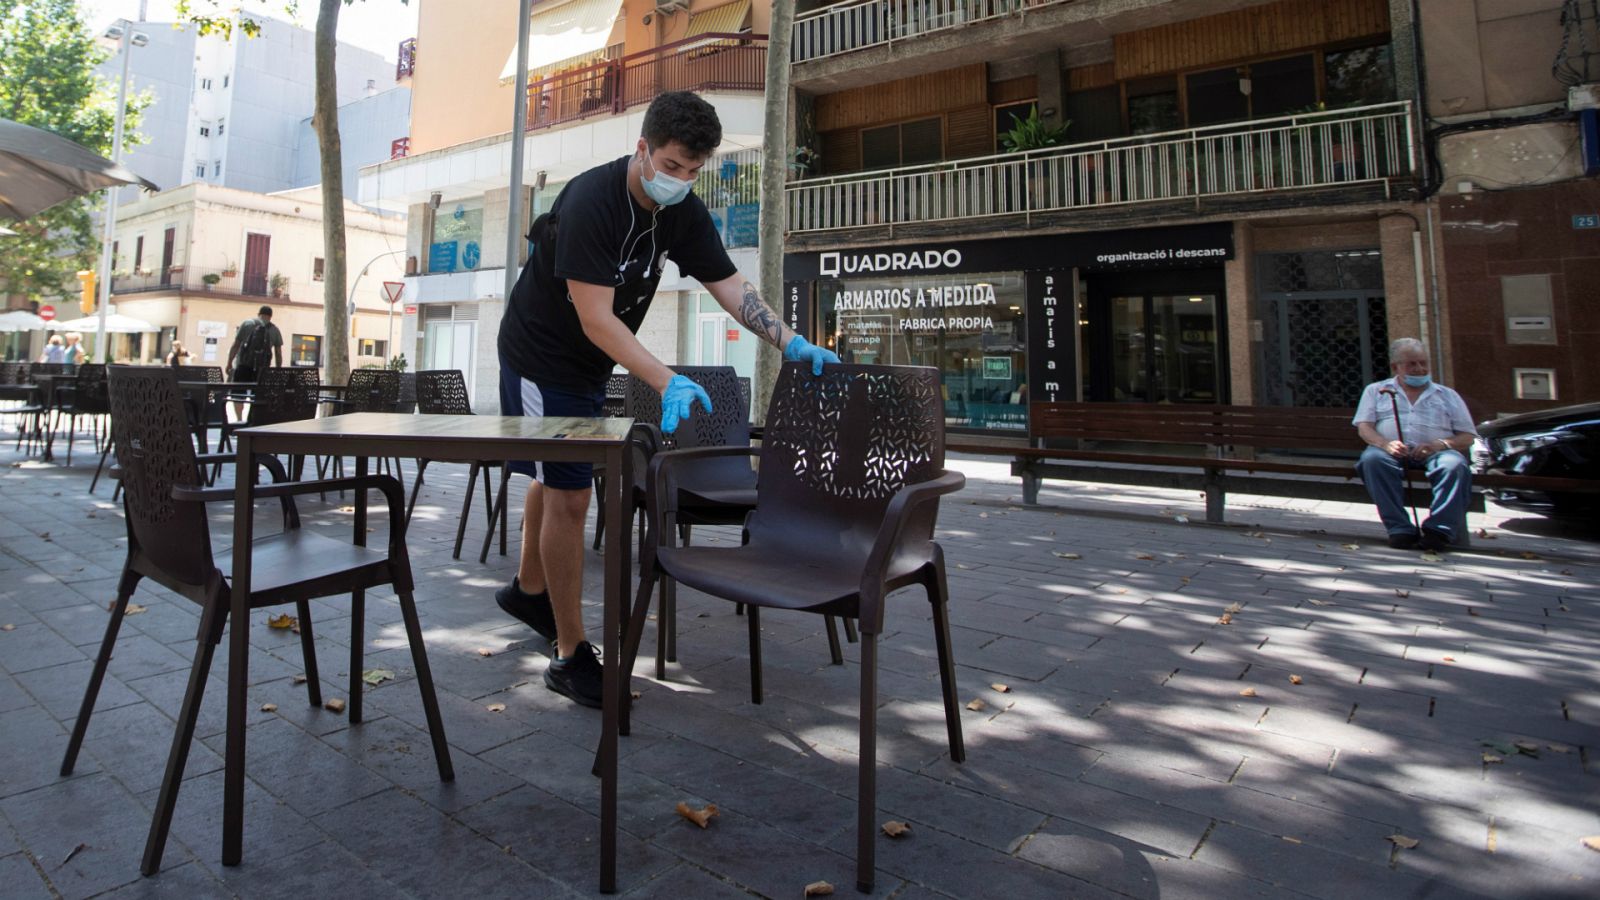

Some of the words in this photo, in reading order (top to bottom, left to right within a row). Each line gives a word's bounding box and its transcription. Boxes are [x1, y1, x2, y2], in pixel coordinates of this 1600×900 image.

[1578, 217, 1594, 227] 25
[820, 249, 962, 278] QUADRADO
[1097, 249, 1167, 263] organització
[1169, 249, 1174, 259] i
[1176, 247, 1226, 259] descans
[834, 288, 911, 311] ARMARIOS
[915, 289, 927, 308] A
[931, 284, 997, 308] MEDIDA
[1043, 275, 1058, 348] armaris
[900, 317, 946, 330] FABRICA
[949, 316, 994, 329] PROPIA
